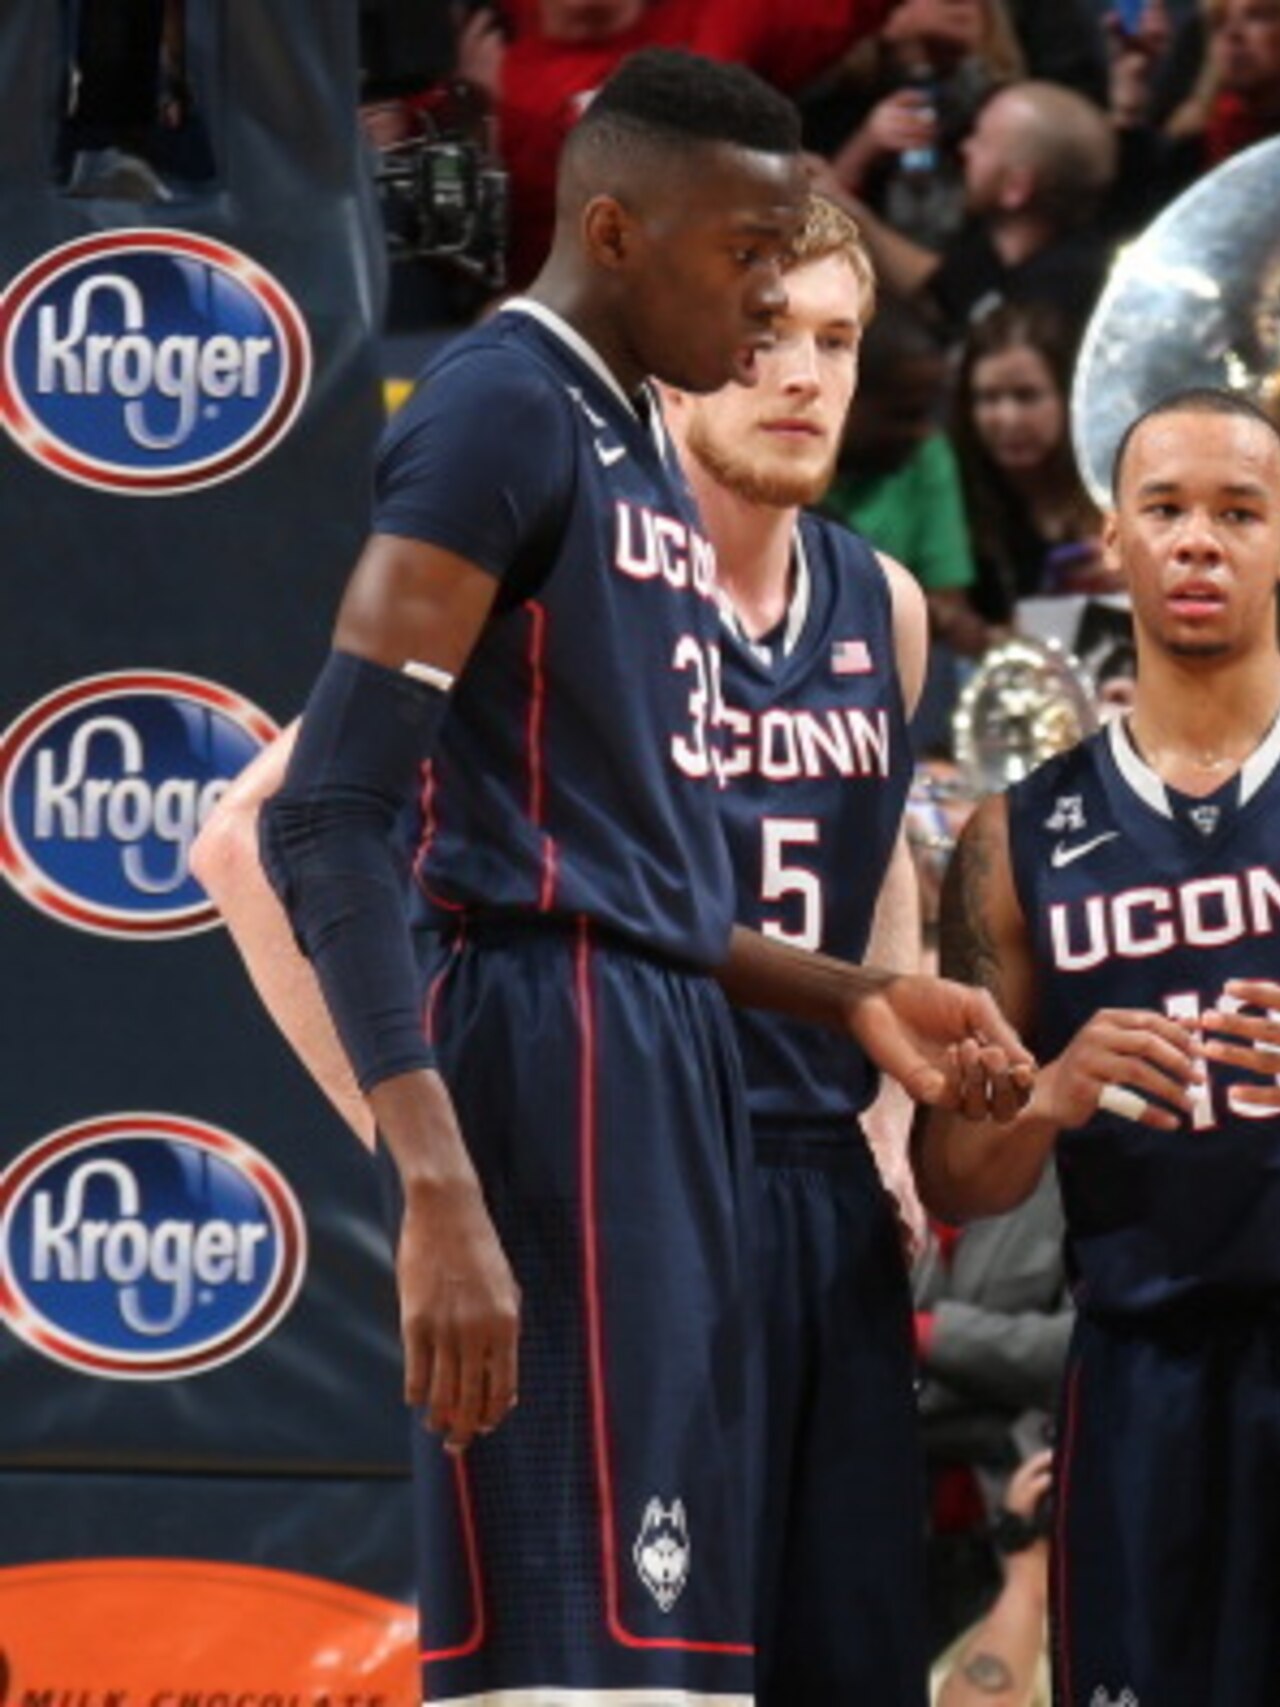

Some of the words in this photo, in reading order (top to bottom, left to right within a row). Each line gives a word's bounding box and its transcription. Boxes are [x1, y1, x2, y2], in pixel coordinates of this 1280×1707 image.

[37, 274, 272, 449] Kroger
[760, 816, 823, 953] 5
[32, 1158, 267, 1336] Kroger
